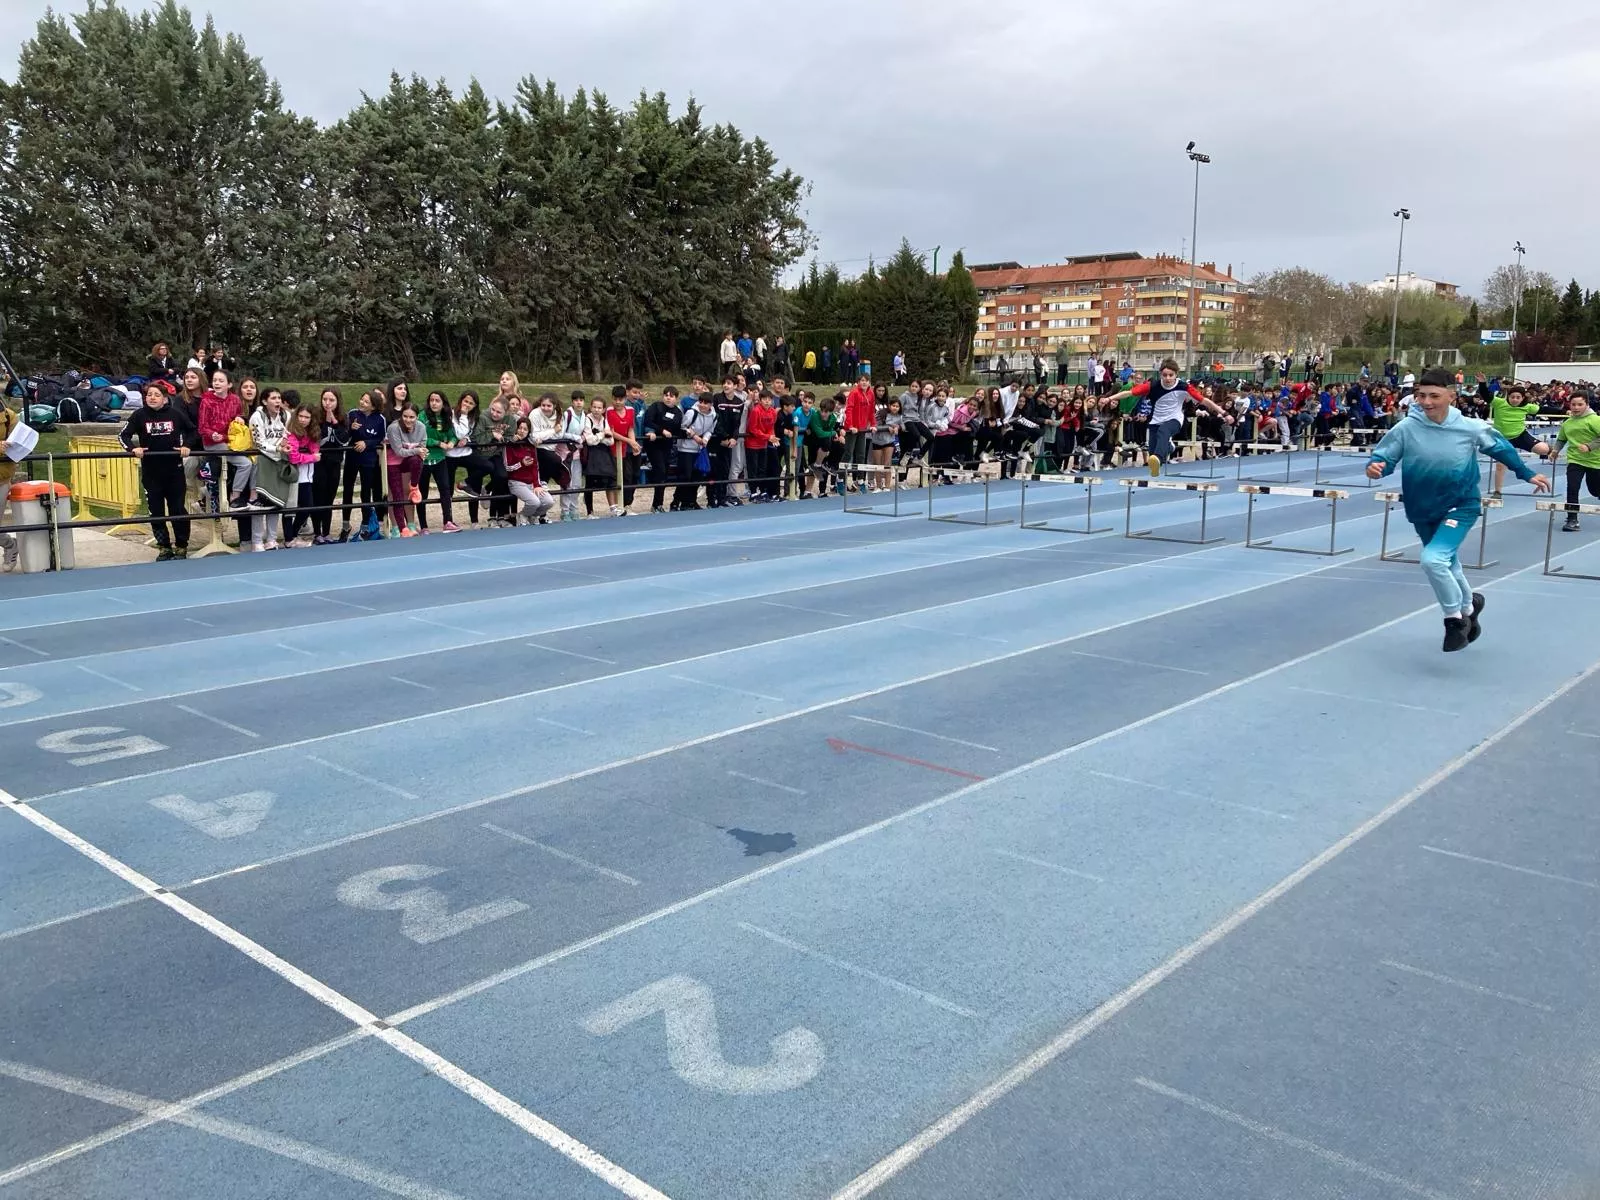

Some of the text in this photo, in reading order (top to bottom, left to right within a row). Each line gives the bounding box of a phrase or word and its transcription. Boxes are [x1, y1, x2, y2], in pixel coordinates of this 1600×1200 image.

[36, 726, 170, 767] 5
[150, 790, 278, 839] 4
[336, 864, 530, 944] 3
[581, 974, 826, 1096] 2
